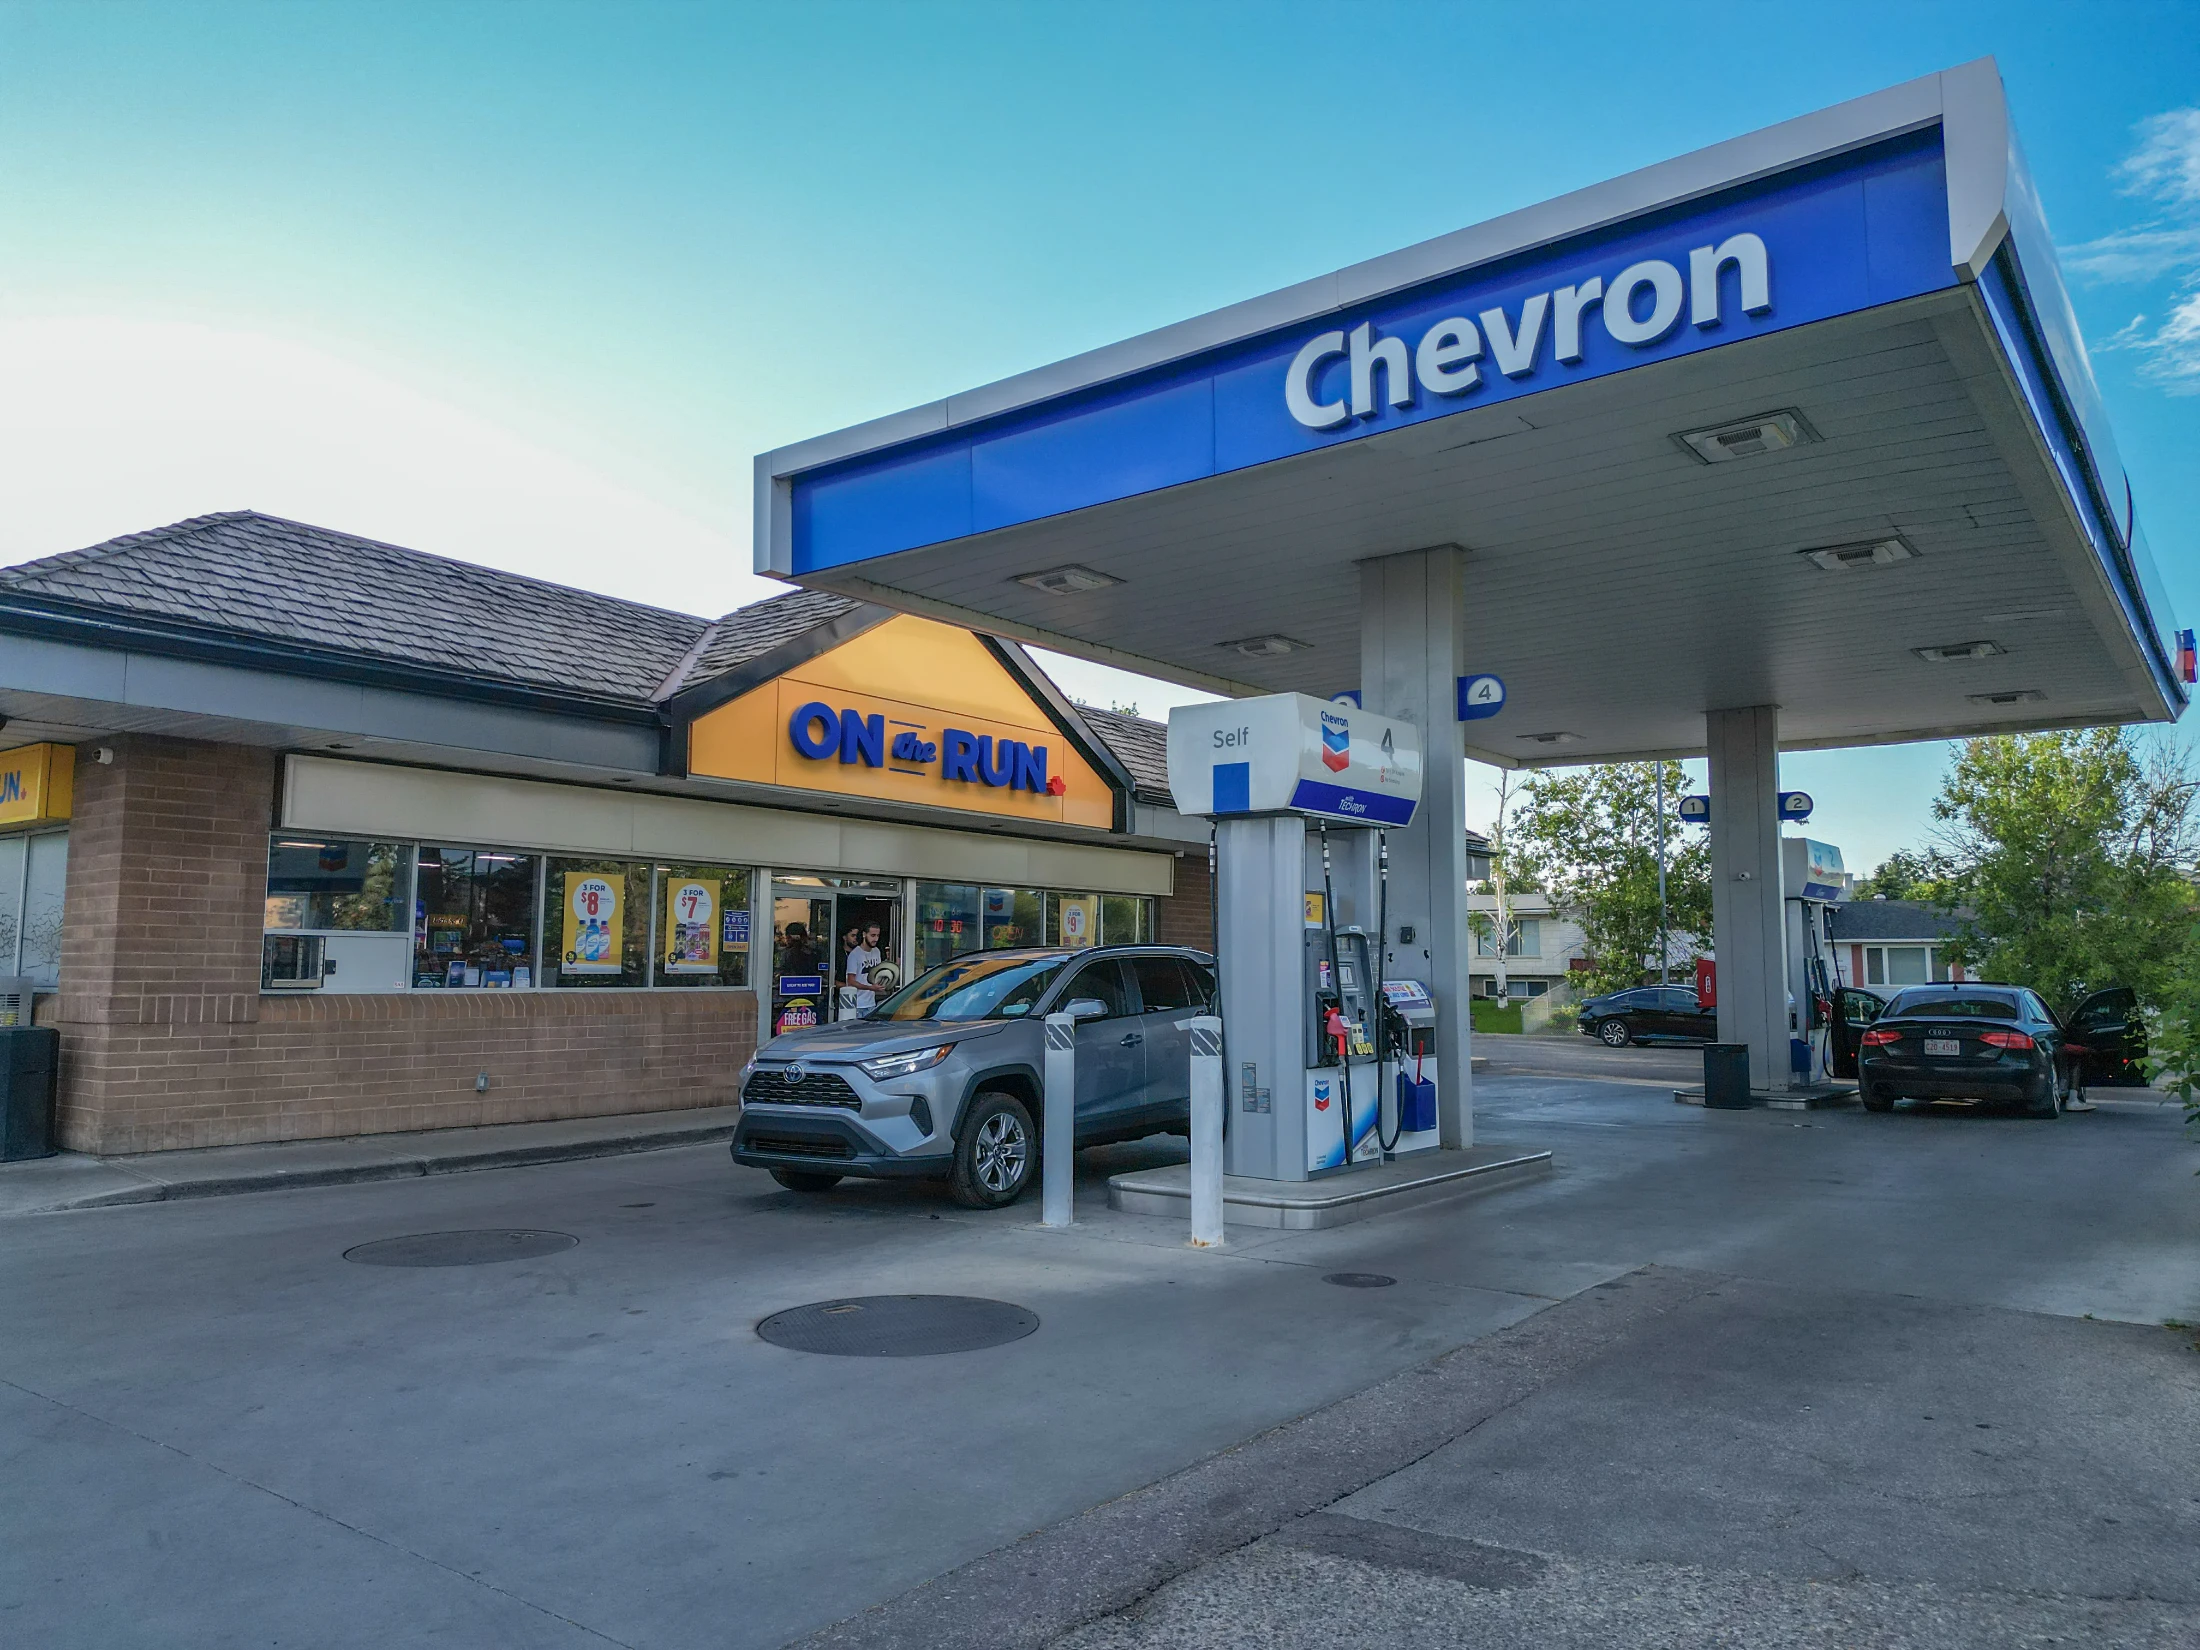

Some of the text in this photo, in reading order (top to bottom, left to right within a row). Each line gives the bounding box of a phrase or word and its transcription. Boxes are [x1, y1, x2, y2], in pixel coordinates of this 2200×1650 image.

[1284, 232, 1773, 431] Chevron
[1477, 684, 1492, 700] 4
[1320, 710, 1349, 727] Chevron
[1213, 726, 1249, 749] Self
[1380, 727, 1395, 760] 4
[789, 701, 1048, 793] ON the RUN
[1338, 799, 1367, 814] TECHRON
[1690, 802, 1695, 812] 1
[1793, 797, 1802, 809] 2
[1828, 850, 1835, 868] 2
[581, 891, 599, 916] $8
[681, 896, 698, 919] $7
[934, 919, 963, 933] 10 30
[1068, 916, 1076, 932] $9
[993, 925, 1024, 940] OPEN
[784, 1011, 817, 1026] FREE GAS
